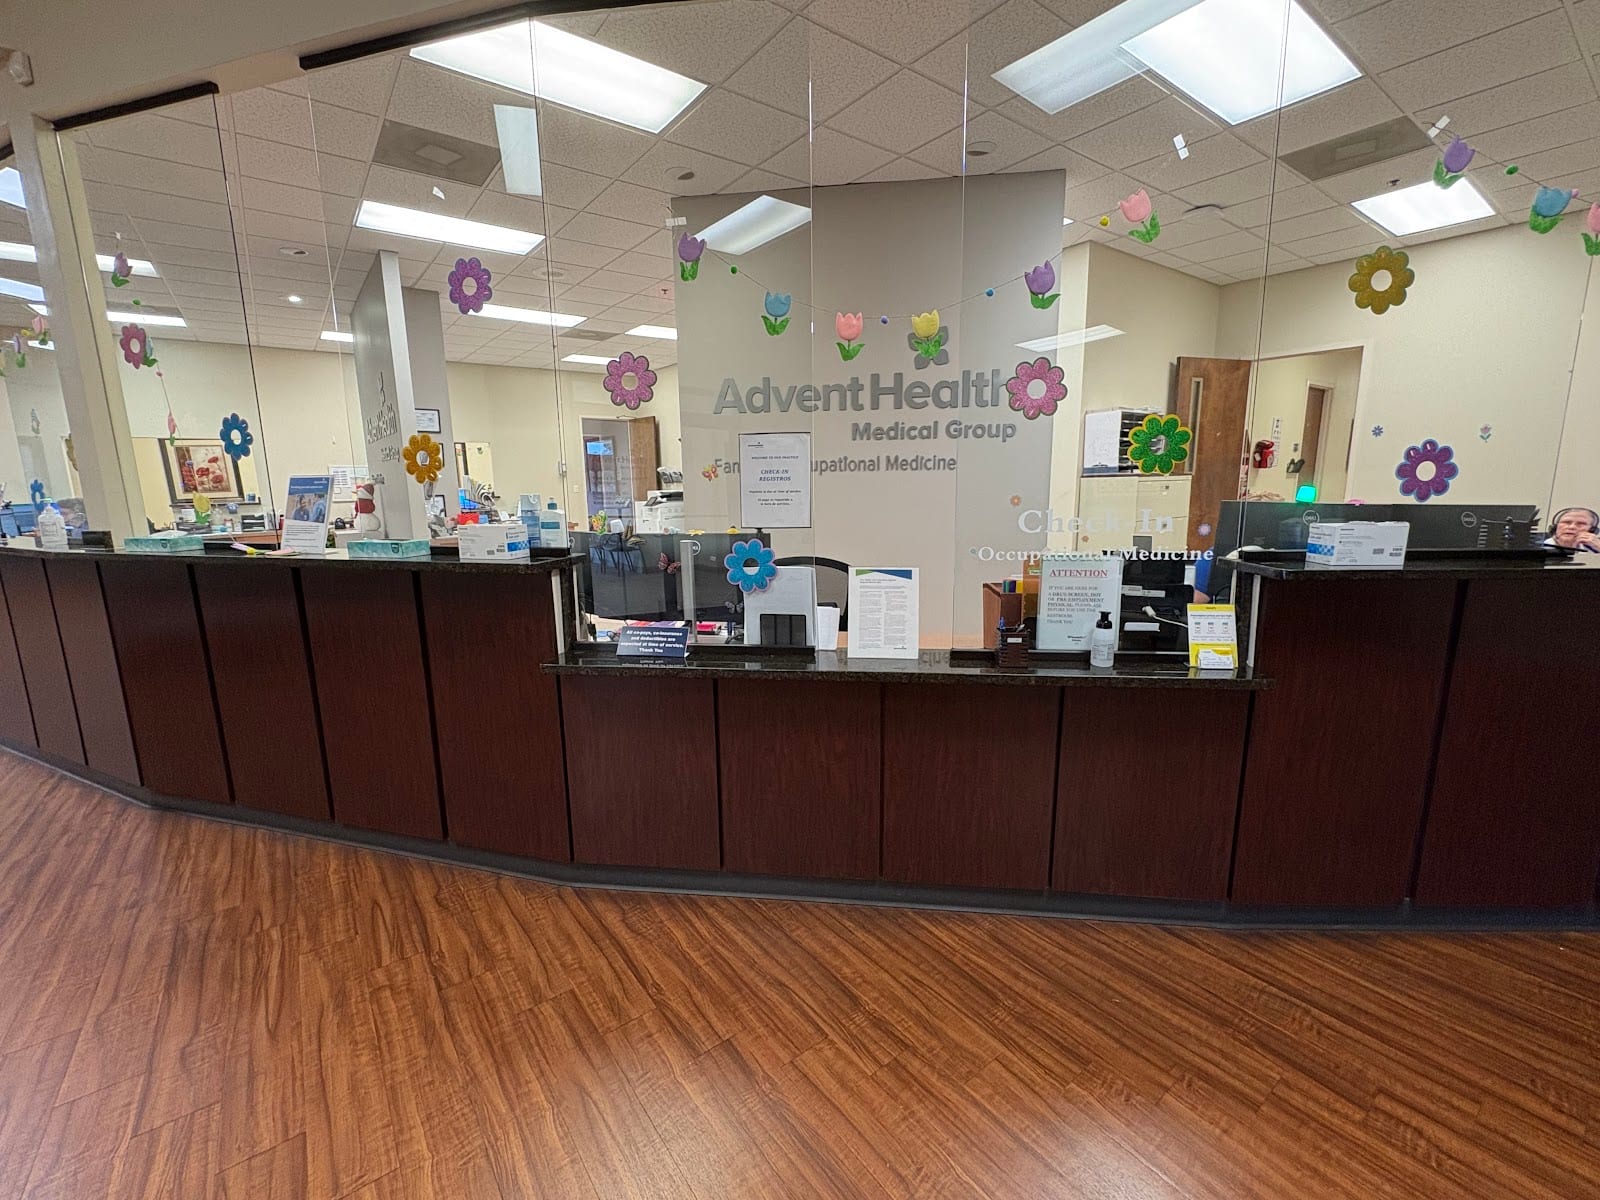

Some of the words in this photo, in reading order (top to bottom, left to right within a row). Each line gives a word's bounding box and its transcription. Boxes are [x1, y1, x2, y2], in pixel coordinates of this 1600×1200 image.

[851, 420, 939, 442] Medical
[945, 419, 1017, 443] Group
[885, 454, 956, 472] Medicine
[1119, 546, 1214, 561] Medicine
[1049, 568, 1108, 578] ATTENTION
